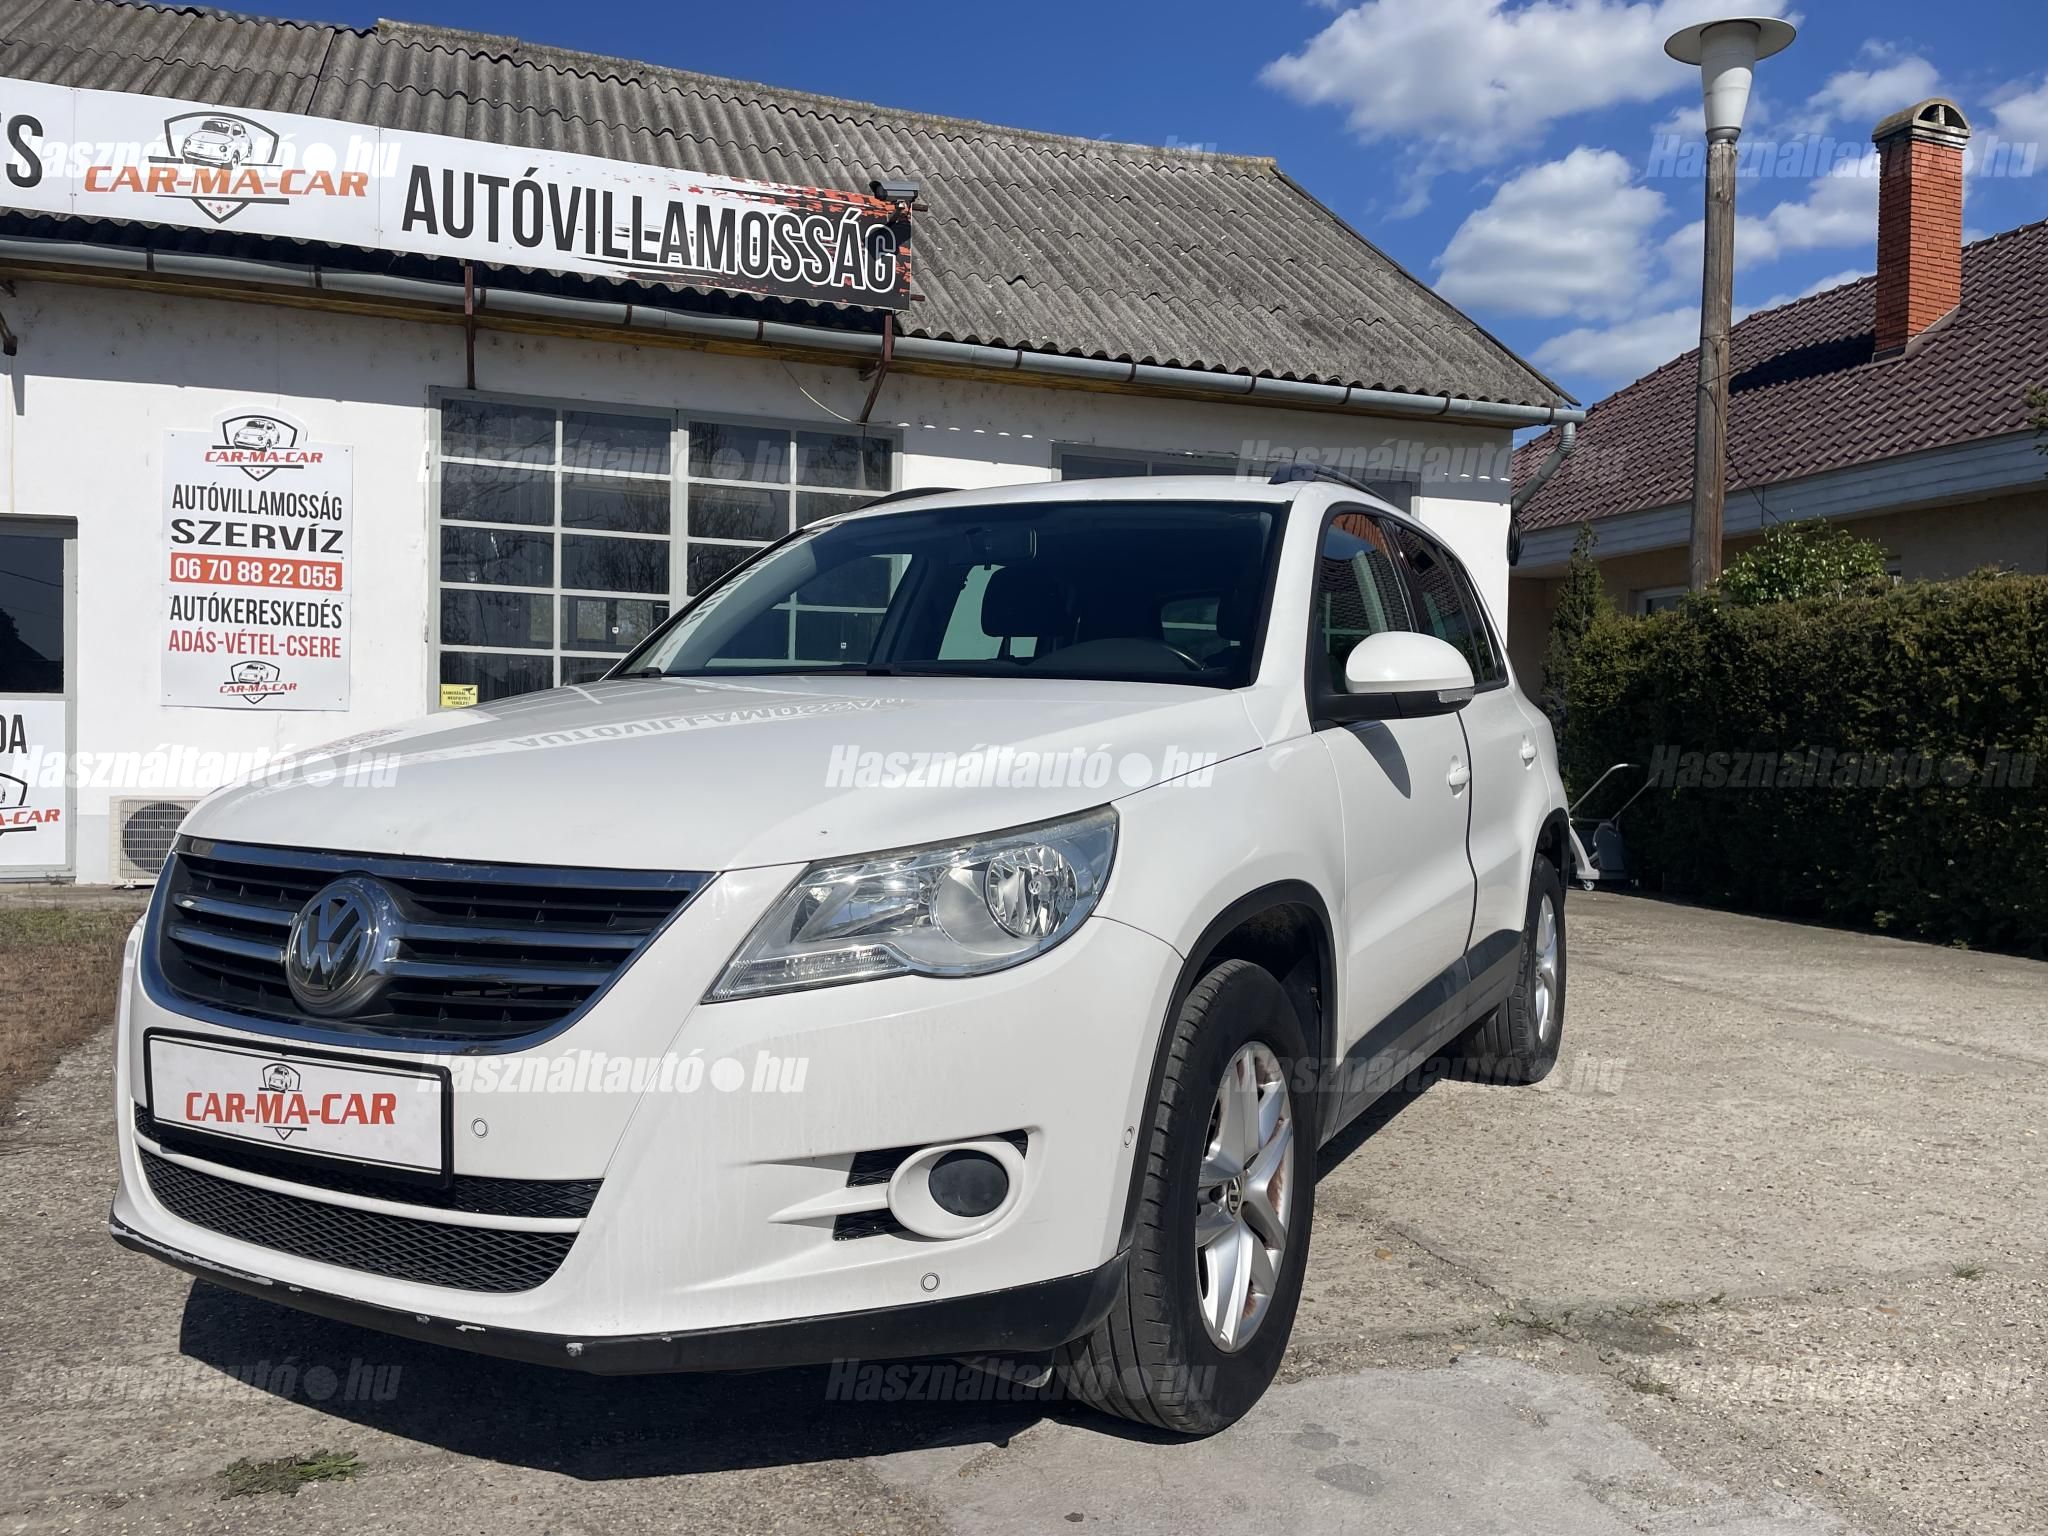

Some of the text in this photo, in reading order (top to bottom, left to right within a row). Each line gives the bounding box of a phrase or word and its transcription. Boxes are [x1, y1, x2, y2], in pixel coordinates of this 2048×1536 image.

[0, 112, 43, 189] S
[84, 165, 369, 197] CAR-MA-CAR
[401, 165, 897, 293] AUTÓVILLAMOSSÁG
[205, 451, 323, 463] CAR-MA-CAR
[172, 482, 342, 520] AUTÓVILLAMOSSÁG
[171, 518, 343, 554] SZERVÍZ
[175, 557, 337, 588] 06 70 88 22 055
[169, 592, 342, 629] AUTÓKERESKEDÉS
[168, 626, 341, 658] ADÁS-VÉTEL-CSERE
[219, 682, 297, 694] CAR-MA-CAR
[186, 1091, 397, 1125] CAR-MA-CAR
